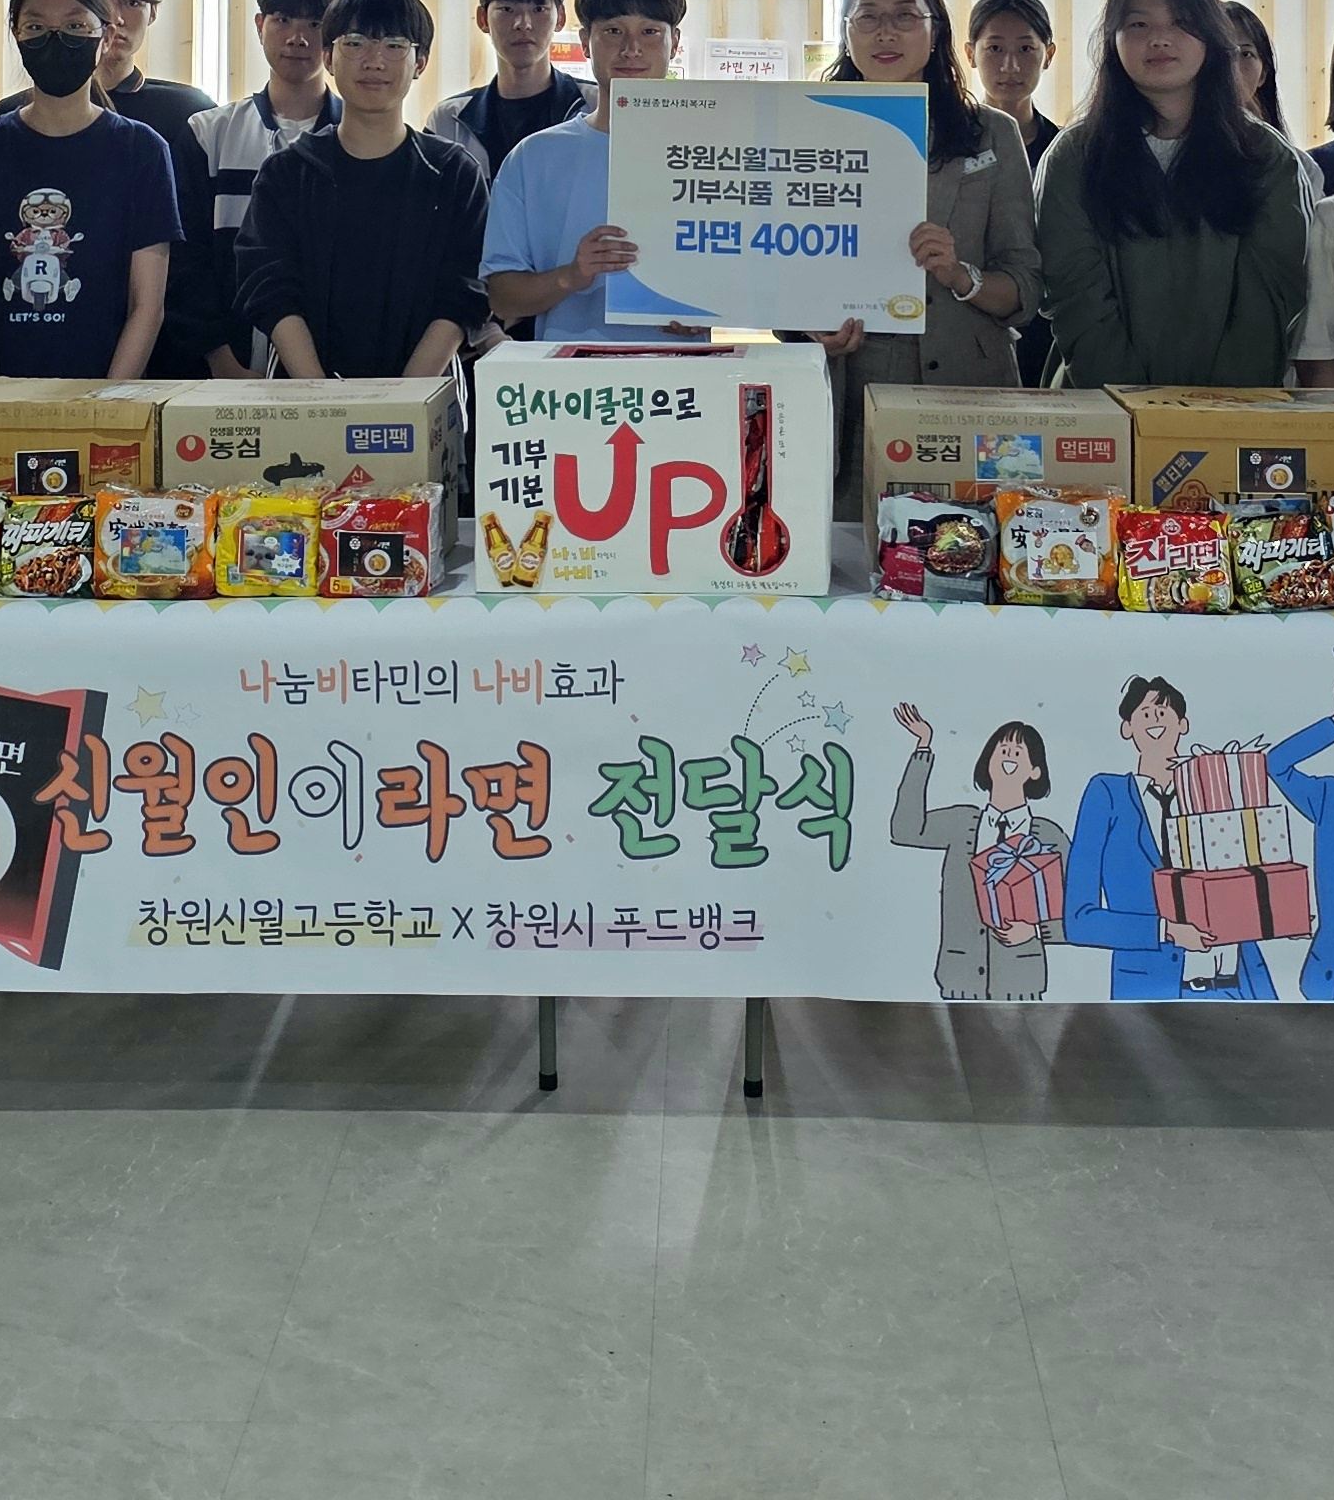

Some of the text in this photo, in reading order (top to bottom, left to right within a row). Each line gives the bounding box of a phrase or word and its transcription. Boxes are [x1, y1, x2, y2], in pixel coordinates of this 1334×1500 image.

[633, 98, 717, 109] 창원종합사회복지관
[666, 145, 869, 174] 창원신월고등학교
[672, 178, 863, 208] 기부식품 전달식
[676, 220, 859, 258] 라면 400개
[35, 260, 48, 275] R
[9, 312, 65, 322] LET'S GO!
[496, 382, 702, 426] 업사이클링으로
[209, 438, 260, 460] 농심
[351, 428, 408, 450] 멀티팩
[491, 438, 547, 470] 기부
[916, 444, 961, 463] 농심
[1061, 440, 1111, 460] 멀티팩
[489, 474, 545, 509] 기분
[2, 521, 91, 557] 짜파게티
[1238, 536, 1326, 573] 짜파게티
[1125, 536, 1222, 580] 진라면
[238, 658, 625, 708] 나눔비타민의 나비효과
[588, 732, 855, 873] 전달식
[135, 899, 443, 949] 창원신월고등학교
[485, 902, 596, 949] 창원시
[607, 899, 765, 949] 푸드뱅크
